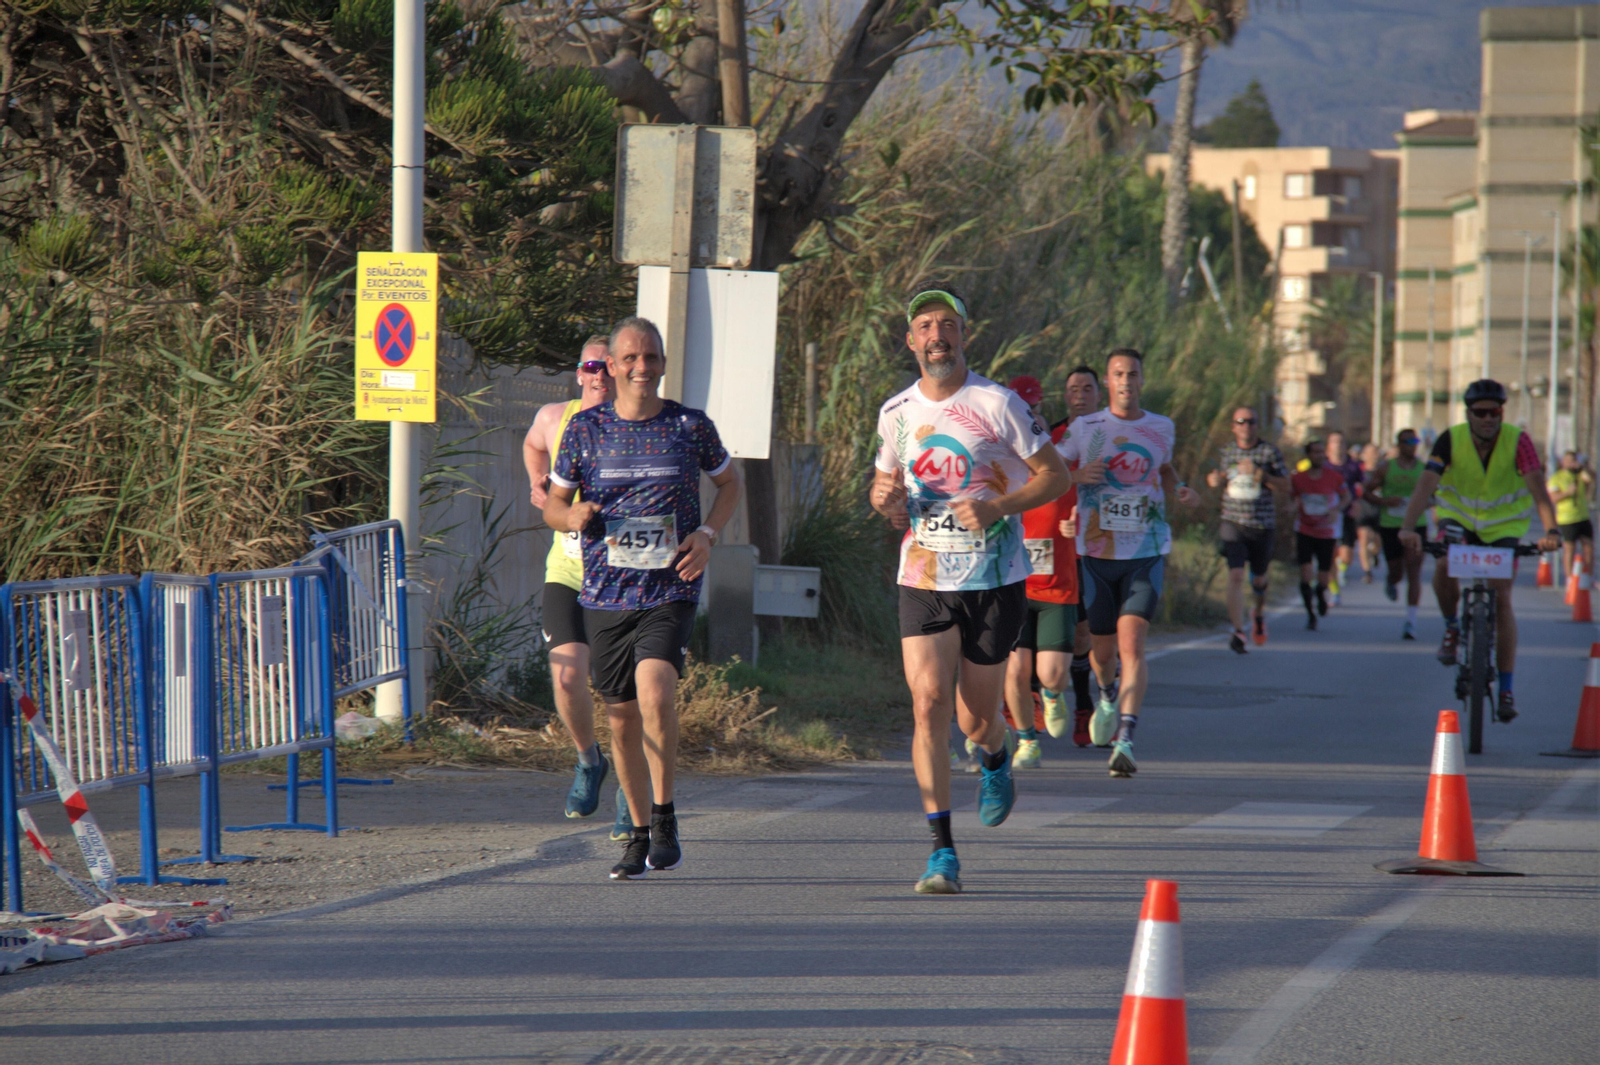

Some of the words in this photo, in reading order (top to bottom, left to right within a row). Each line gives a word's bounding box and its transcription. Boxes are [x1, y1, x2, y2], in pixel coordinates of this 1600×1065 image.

[366, 265, 428, 277] SEÑALIZACIÓN
[366, 278, 426, 289] EXCEPCIONAL
[378, 291, 428, 300] EVENTOS
[1109, 503, 1141, 518] 481
[618, 529, 664, 549] 457
[1483, 554, 1502, 566] 40
